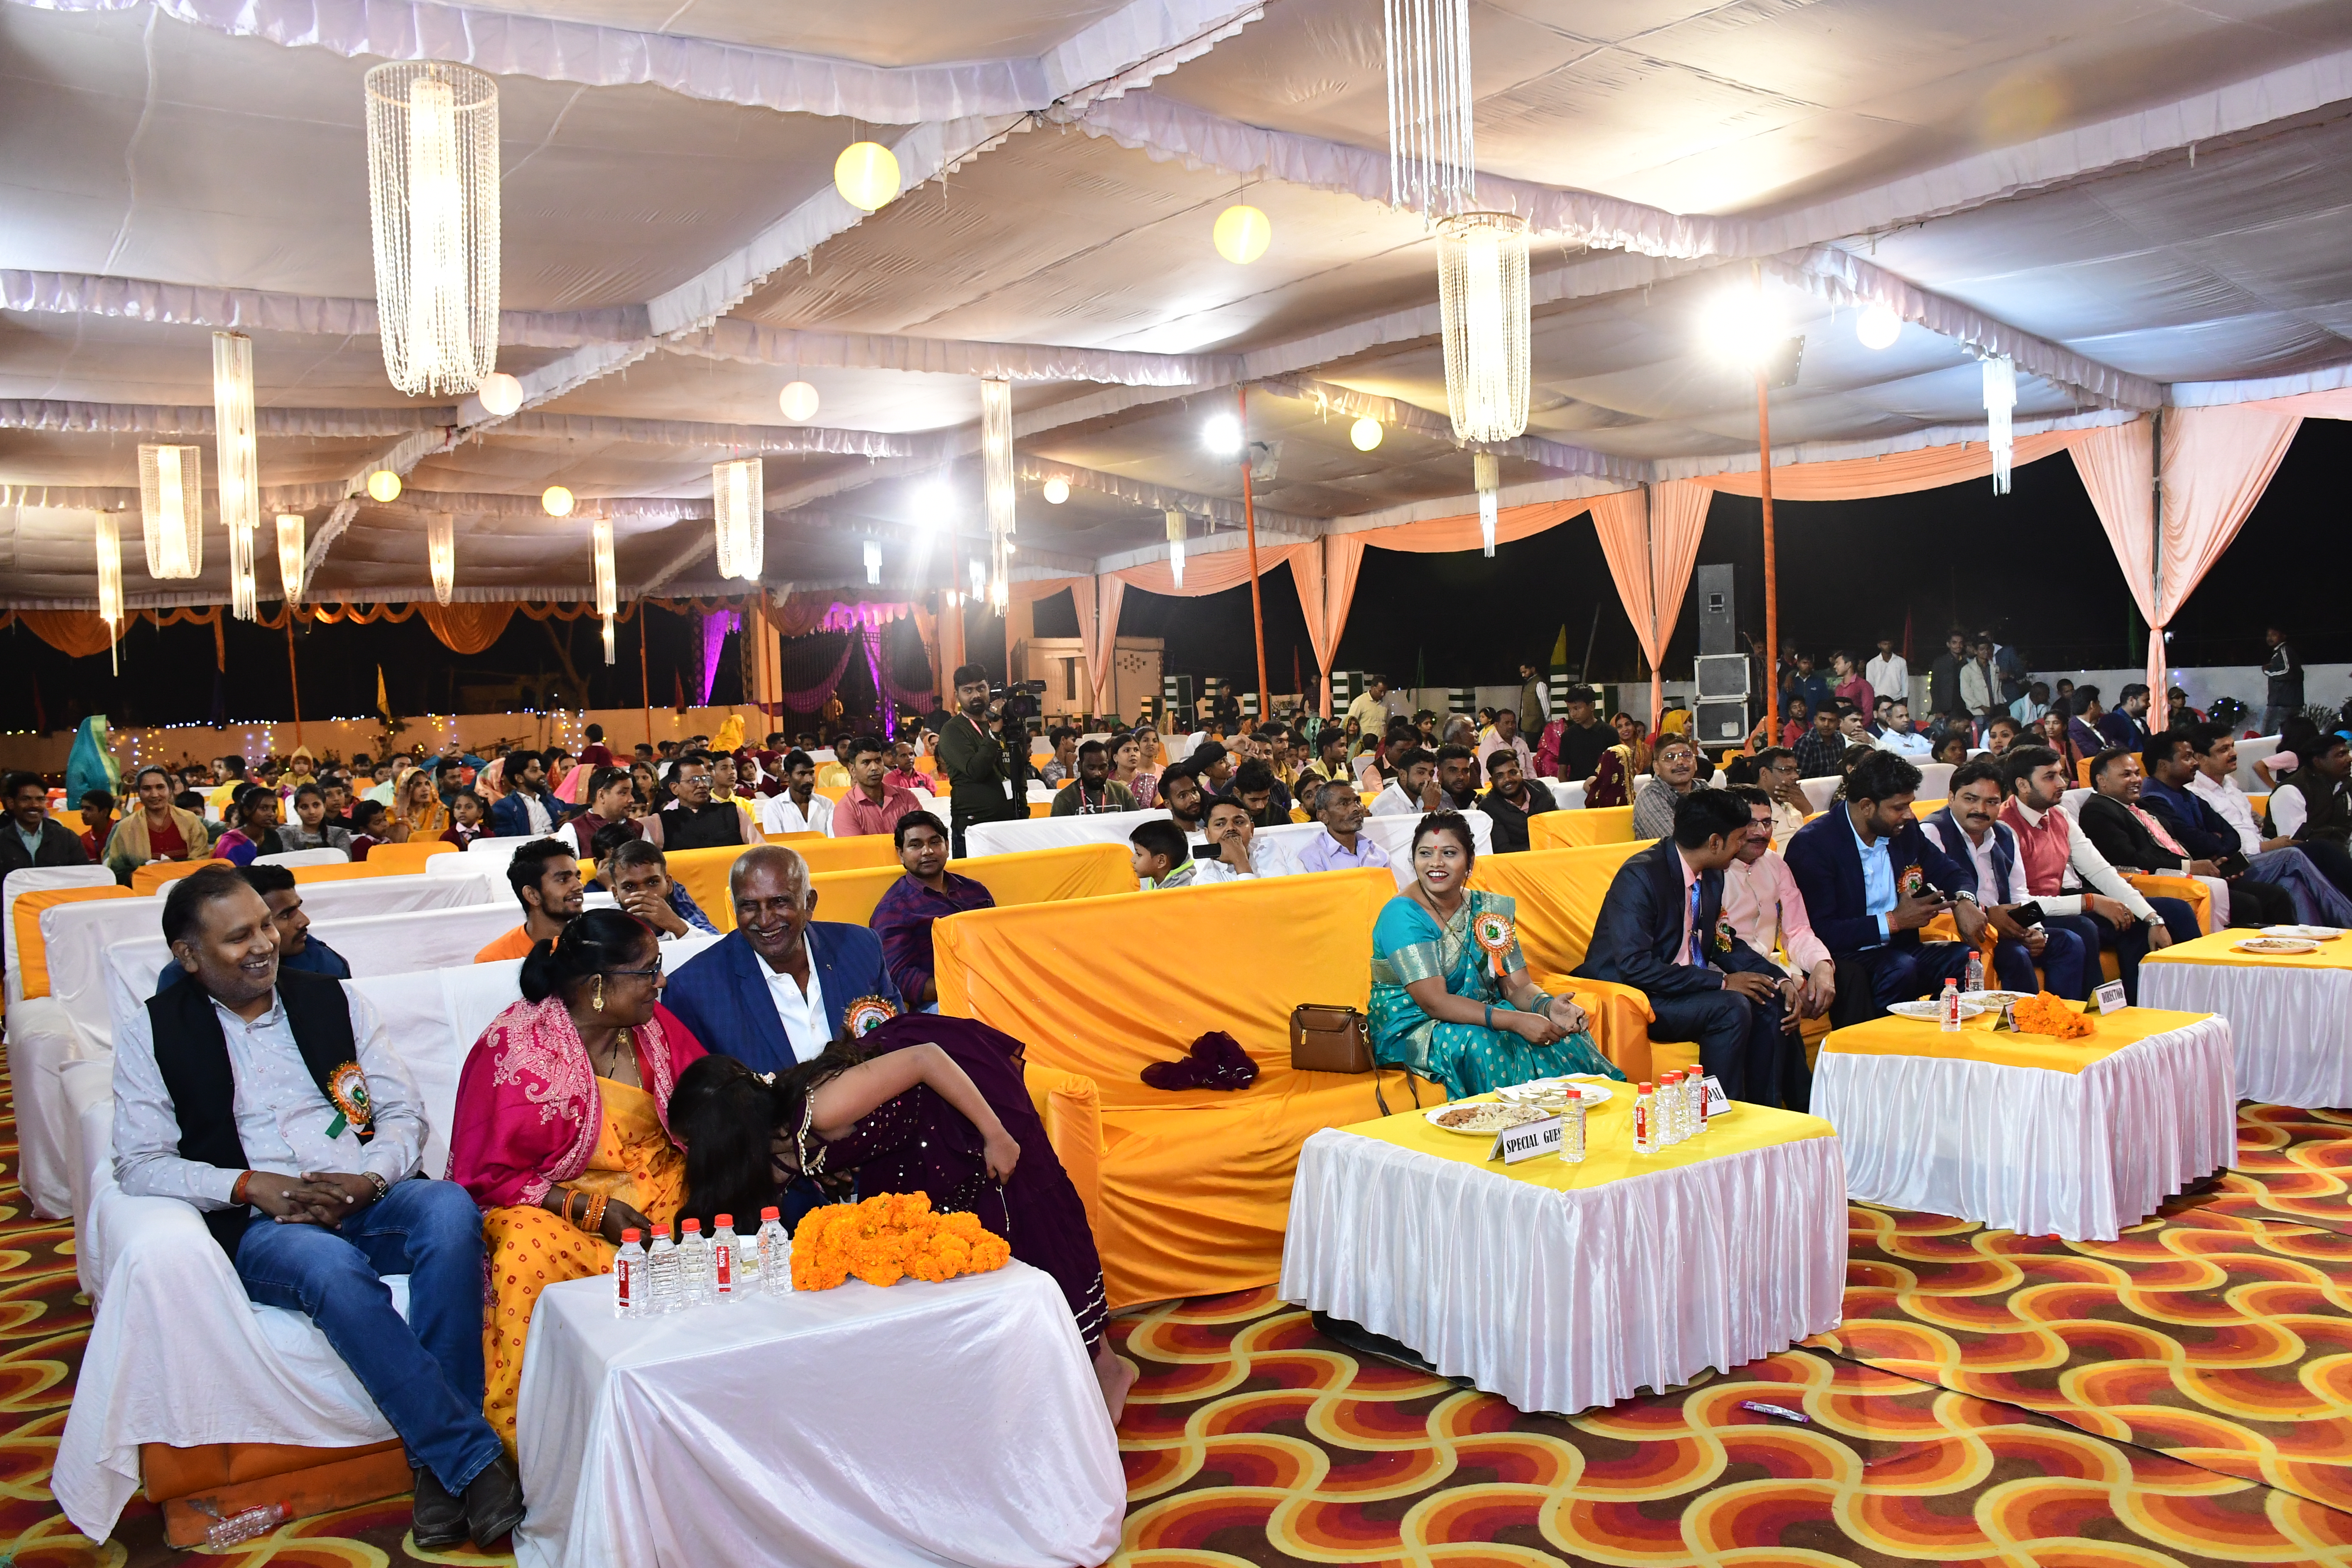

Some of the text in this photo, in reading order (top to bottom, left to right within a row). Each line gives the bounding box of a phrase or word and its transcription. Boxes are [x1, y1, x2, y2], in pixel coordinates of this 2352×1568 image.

[2101, 988, 2123, 1004] DIRECTOR
[1707, 1087, 1724, 1103] PAL
[1506, 1127, 1561, 1153] SPECIAL GUES
